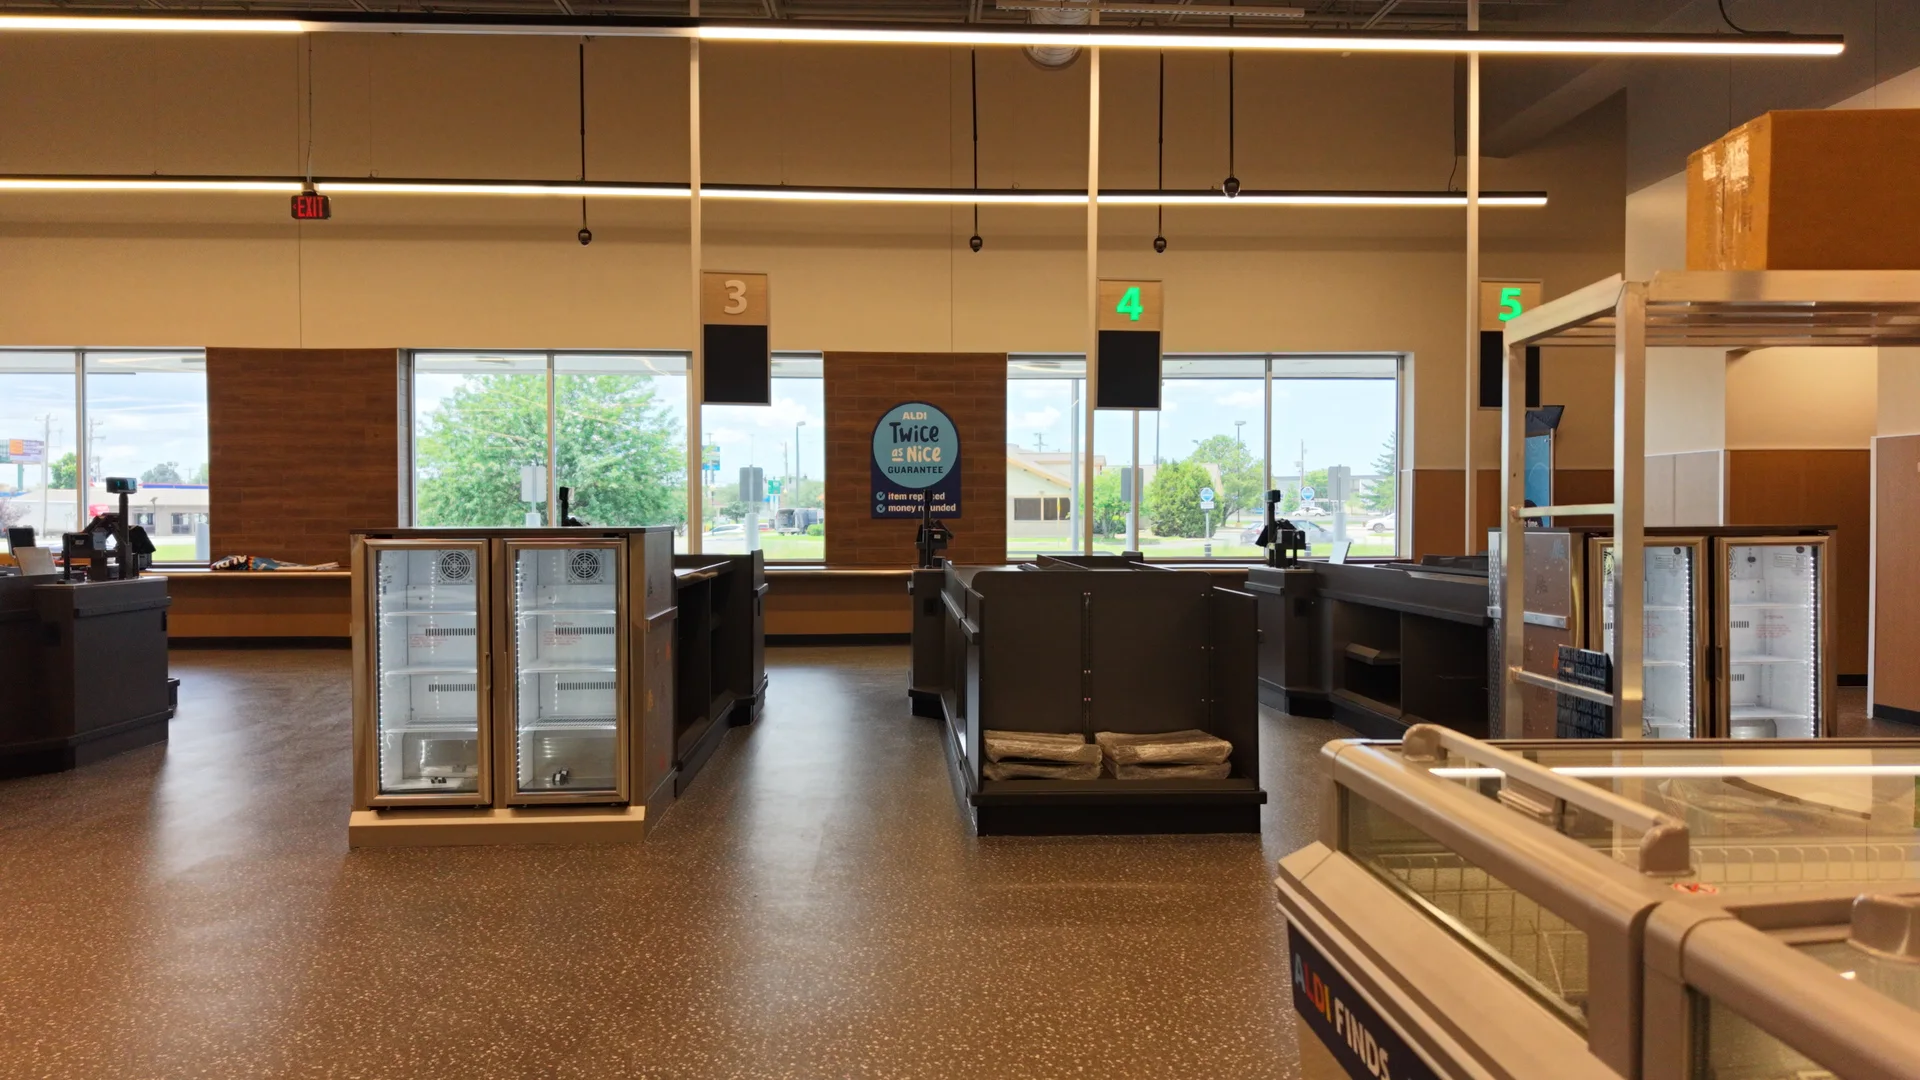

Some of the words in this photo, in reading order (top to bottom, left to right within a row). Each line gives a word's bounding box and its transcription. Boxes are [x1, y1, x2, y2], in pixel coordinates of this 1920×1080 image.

[297, 196, 324, 217] EXIT
[723, 279, 748, 315] 3
[1116, 286, 1144, 321] 4
[1498, 287, 1523, 322] 5
[902, 411, 927, 420] ALDI
[889, 422, 939, 444] Twice
[892, 448, 903, 459] as
[907, 446, 941, 462] Nice
[888, 466, 943, 474] GUARANTEE
[888, 491, 907, 500] item
[909, 491, 945, 502] reped
[888, 504, 916, 514] money
[917, 503, 956, 512] runded
[1294, 952, 1332, 1023] ALDI
[1334, 996, 1390, 1080] FINDS
